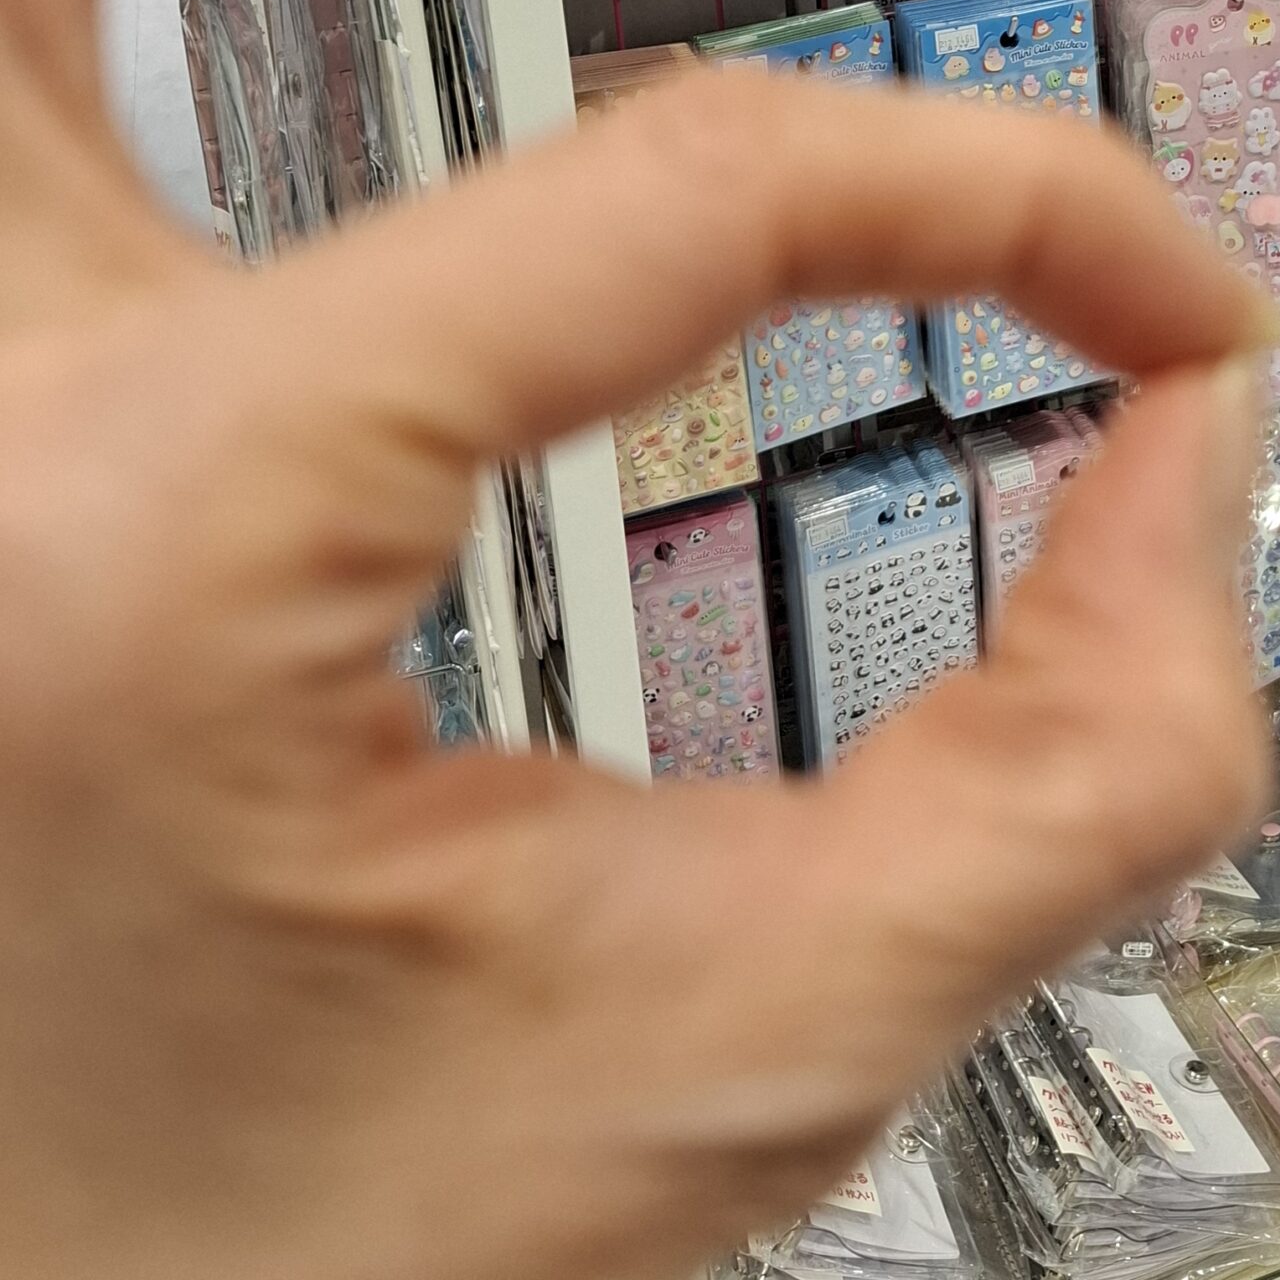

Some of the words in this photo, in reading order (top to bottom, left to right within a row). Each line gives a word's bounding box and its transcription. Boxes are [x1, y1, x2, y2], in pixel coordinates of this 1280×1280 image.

[1010, 47, 1032, 63] Mini
[1034, 43, 1052, 54] Cute
[1055, 40, 1088, 50] Stickers
[1160, 50, 1207, 63] ANIMAL
[852, 62, 886, 73] Stickers
[998, 490, 1019, 500] Mini
[1021, 478, 1058, 495] Animals
[893, 523, 929, 539] Sticker
[690, 551, 711, 563] Cute
[713, 545, 750, 557] Stickers
